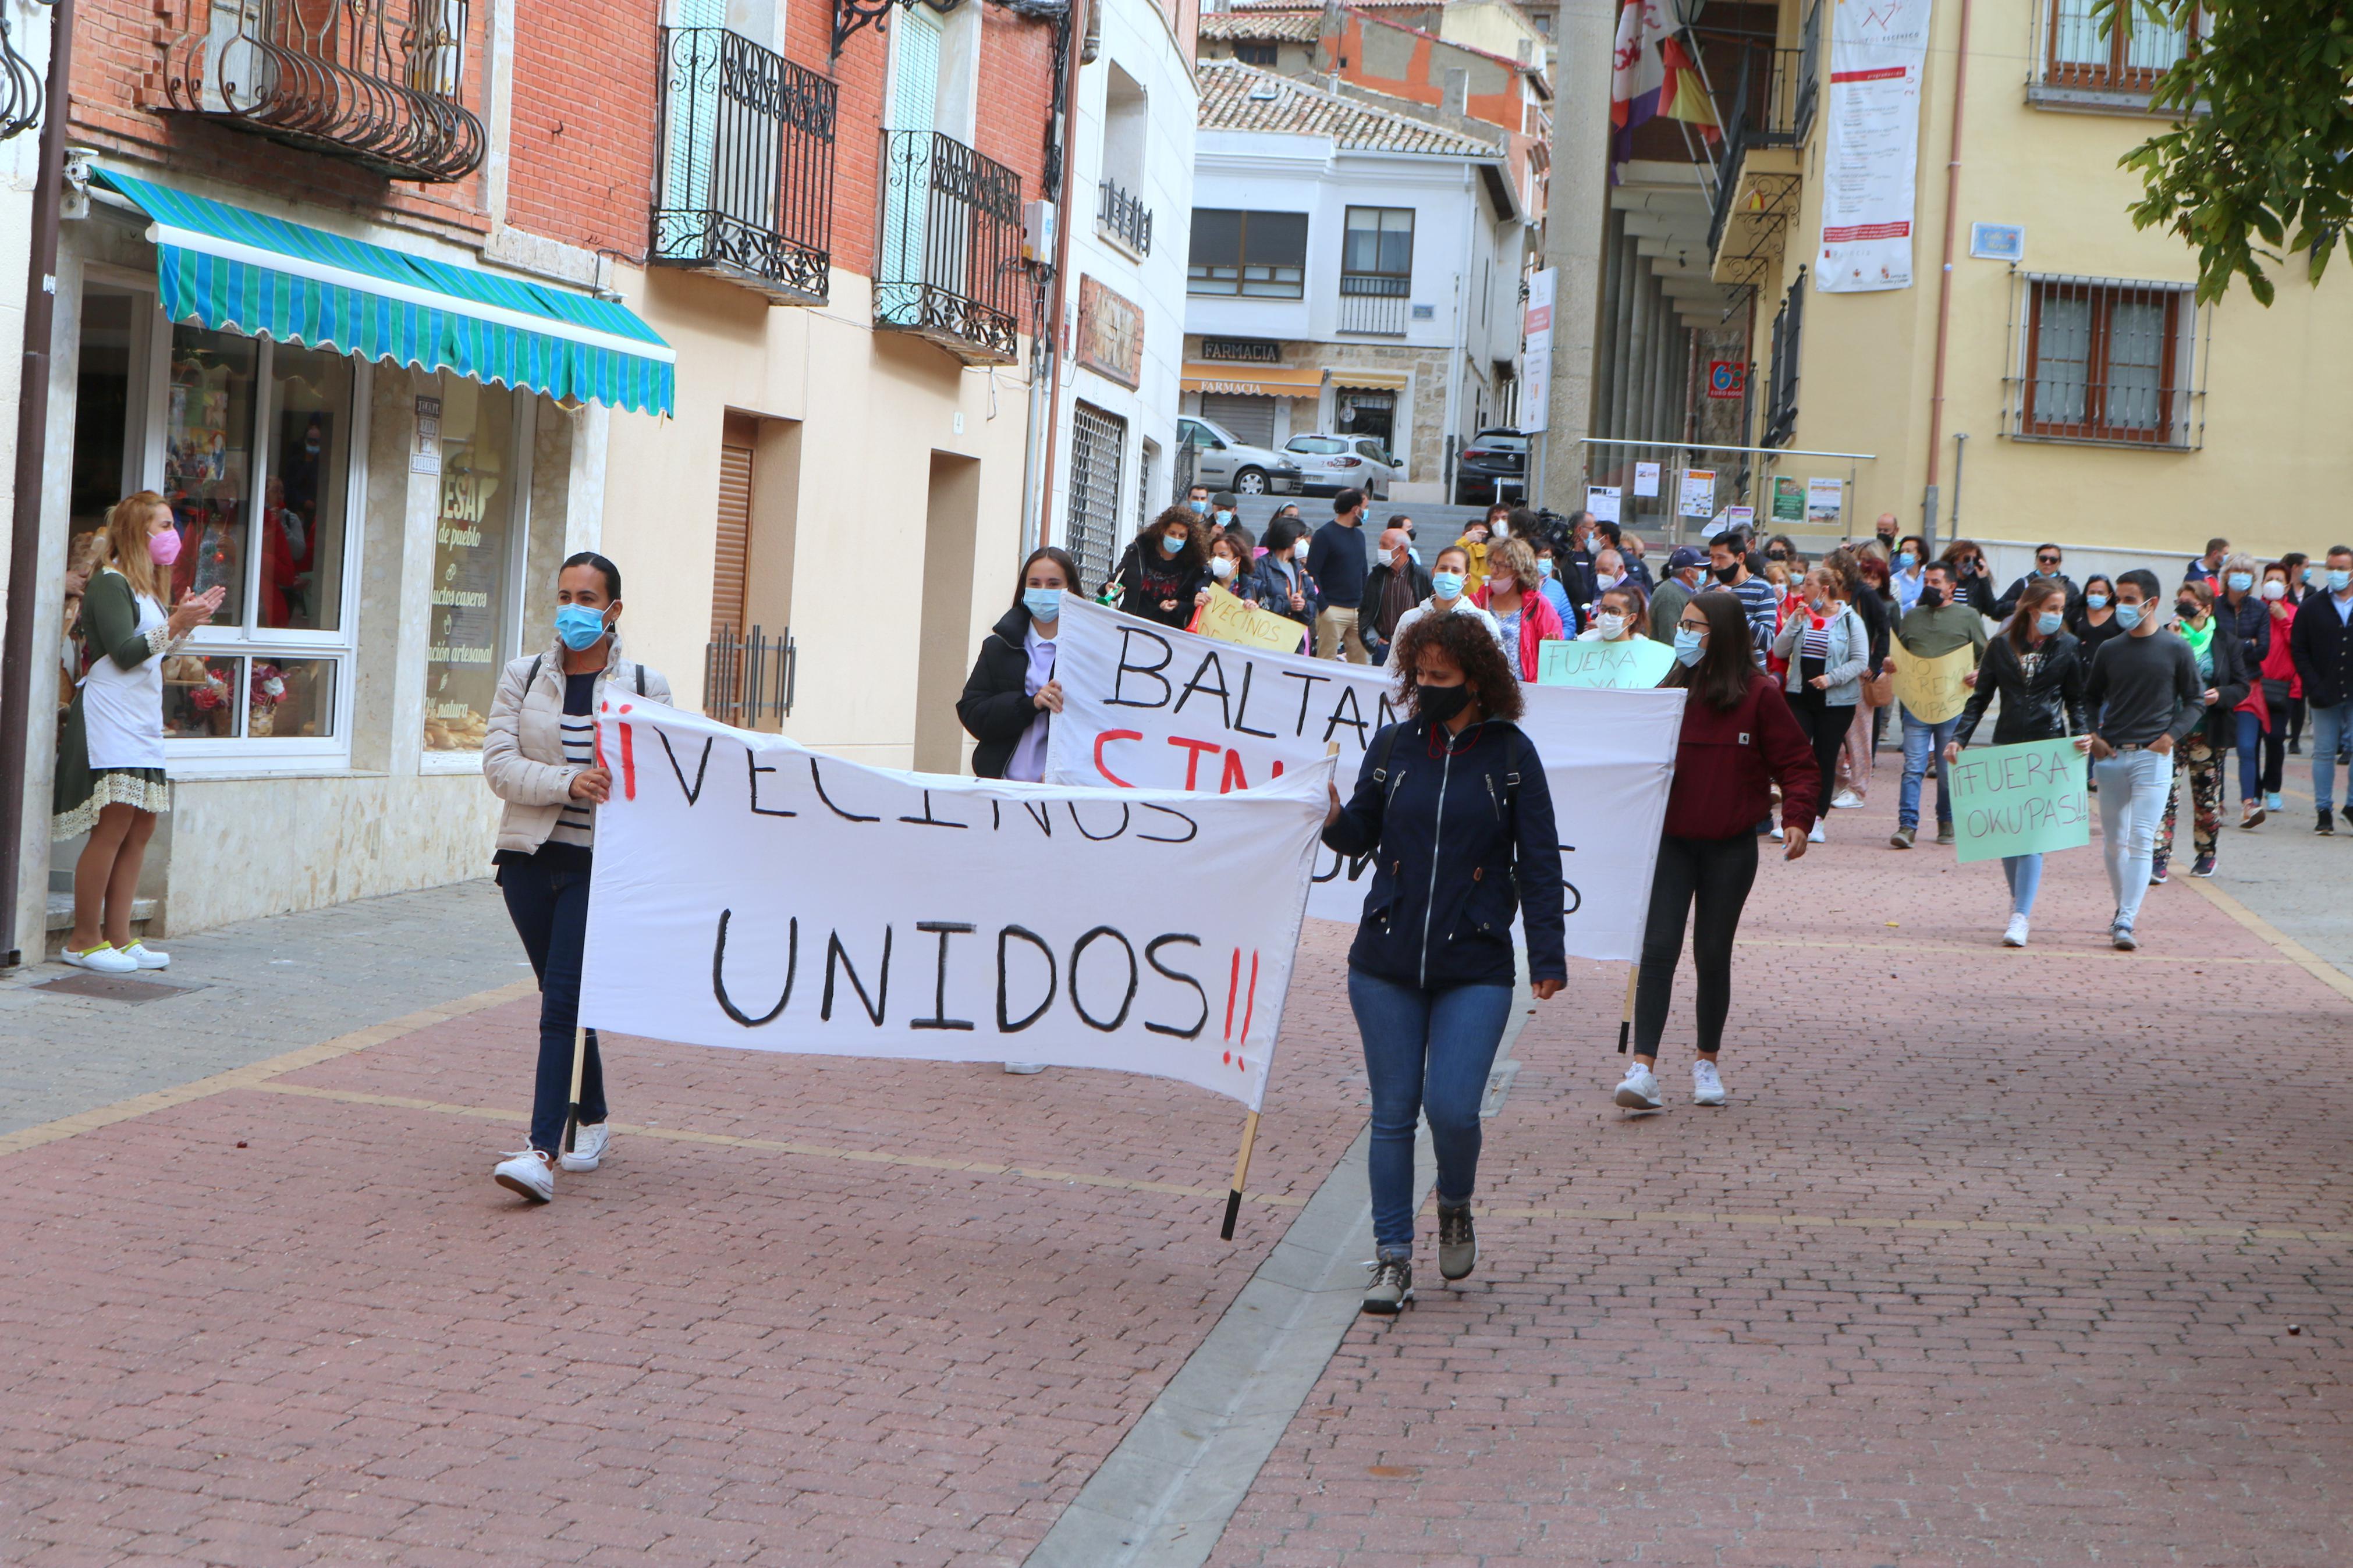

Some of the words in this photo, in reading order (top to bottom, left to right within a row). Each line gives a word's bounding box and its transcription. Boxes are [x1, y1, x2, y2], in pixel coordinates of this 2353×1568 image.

[1204, 342, 1276, 361] FARMACIA
[1201, 381, 1261, 393] FARMACIA
[415, 457, 436, 470] DULCES
[438, 522, 449, 544] de
[449, 525, 481, 552] pueblo
[431, 586, 455, 607] uctos
[456, 591, 487, 607] caseros
[451, 643, 494, 663] artesanal
[1548, 644, 1637, 677] FUERA
[1967, 791, 2088, 838] OKUPAS!!
[712, 908, 1259, 1073] UNIDOS!!
